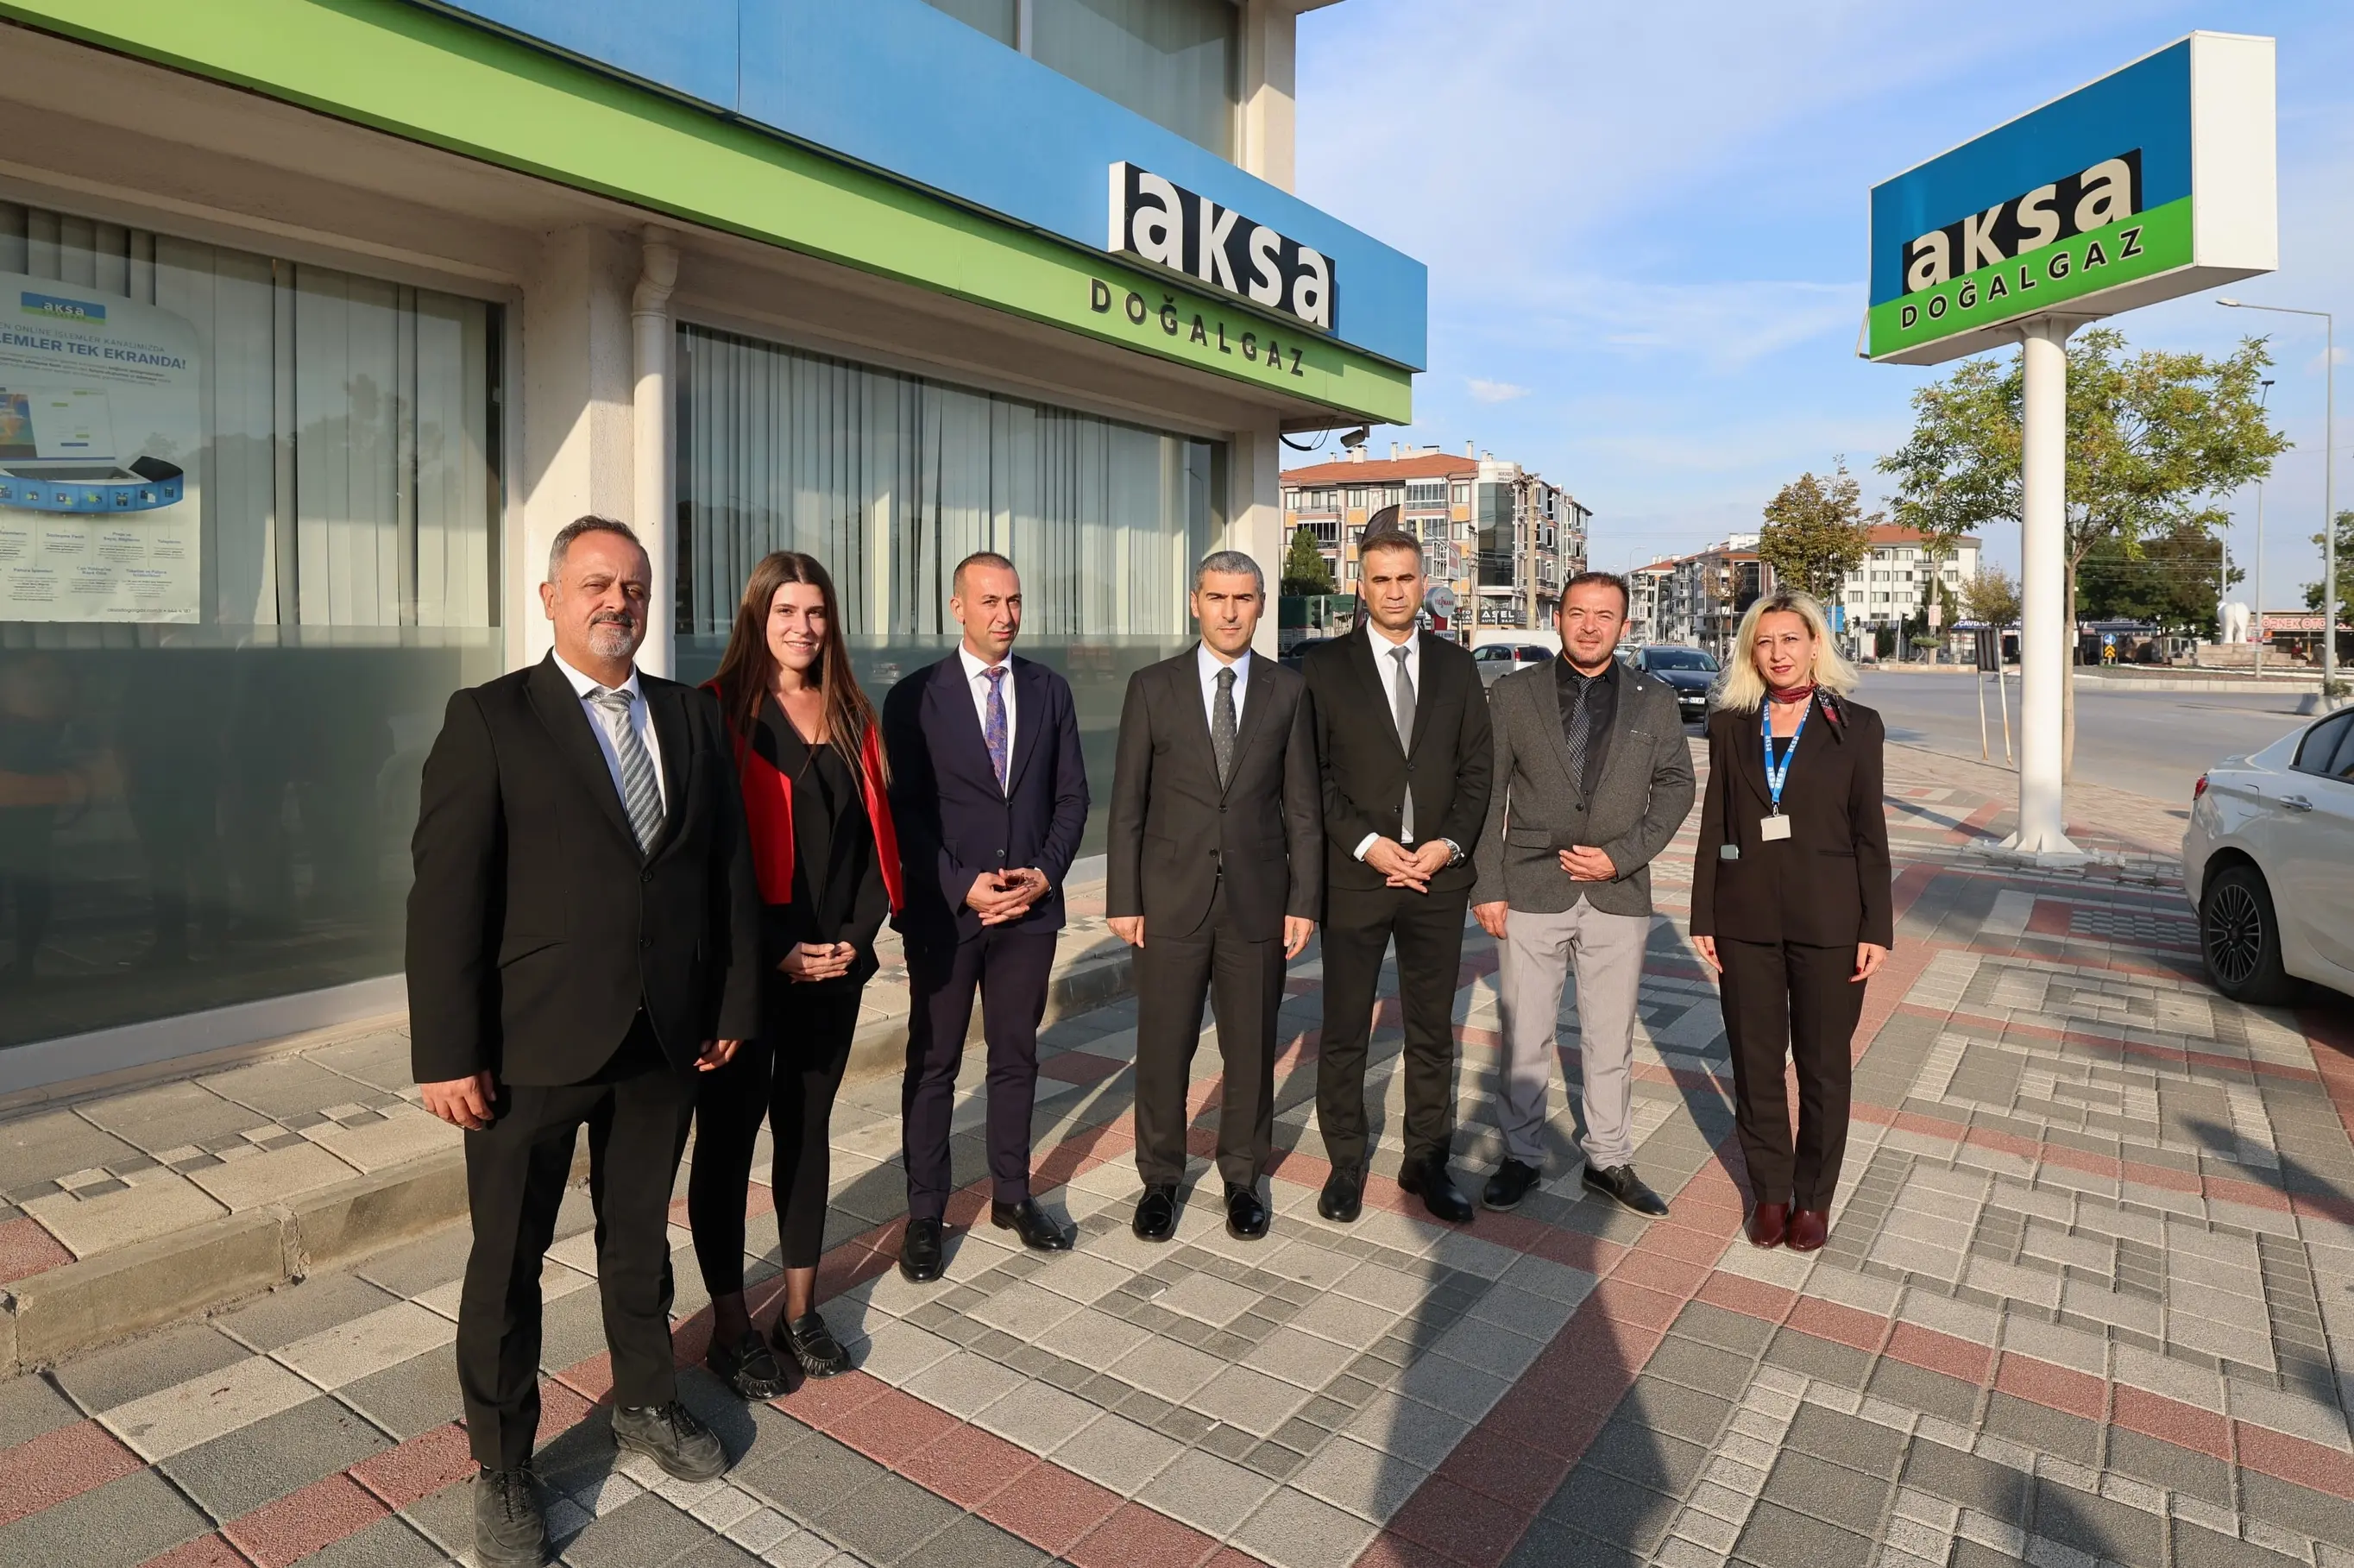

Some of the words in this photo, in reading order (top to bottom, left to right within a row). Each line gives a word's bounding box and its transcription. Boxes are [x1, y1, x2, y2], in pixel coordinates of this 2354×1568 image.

[1907, 159, 2131, 293] aksa
[1132, 173, 1330, 329] aksa
[1901, 226, 2143, 330] DOĞALGAZ
[43, 302, 85, 317] aksa
[1090, 277, 1304, 377] DOĞALGAZ
[0, 332, 62, 351] EMLER
[66, 342, 99, 357] TEK
[104, 347, 186, 369] EKRANDA!
[2262, 615, 2301, 629] ÖRNEK
[2301, 617, 2326, 629] OTO
[1787, 736, 1799, 753] aksa
[1775, 767, 1785, 788] aksa
